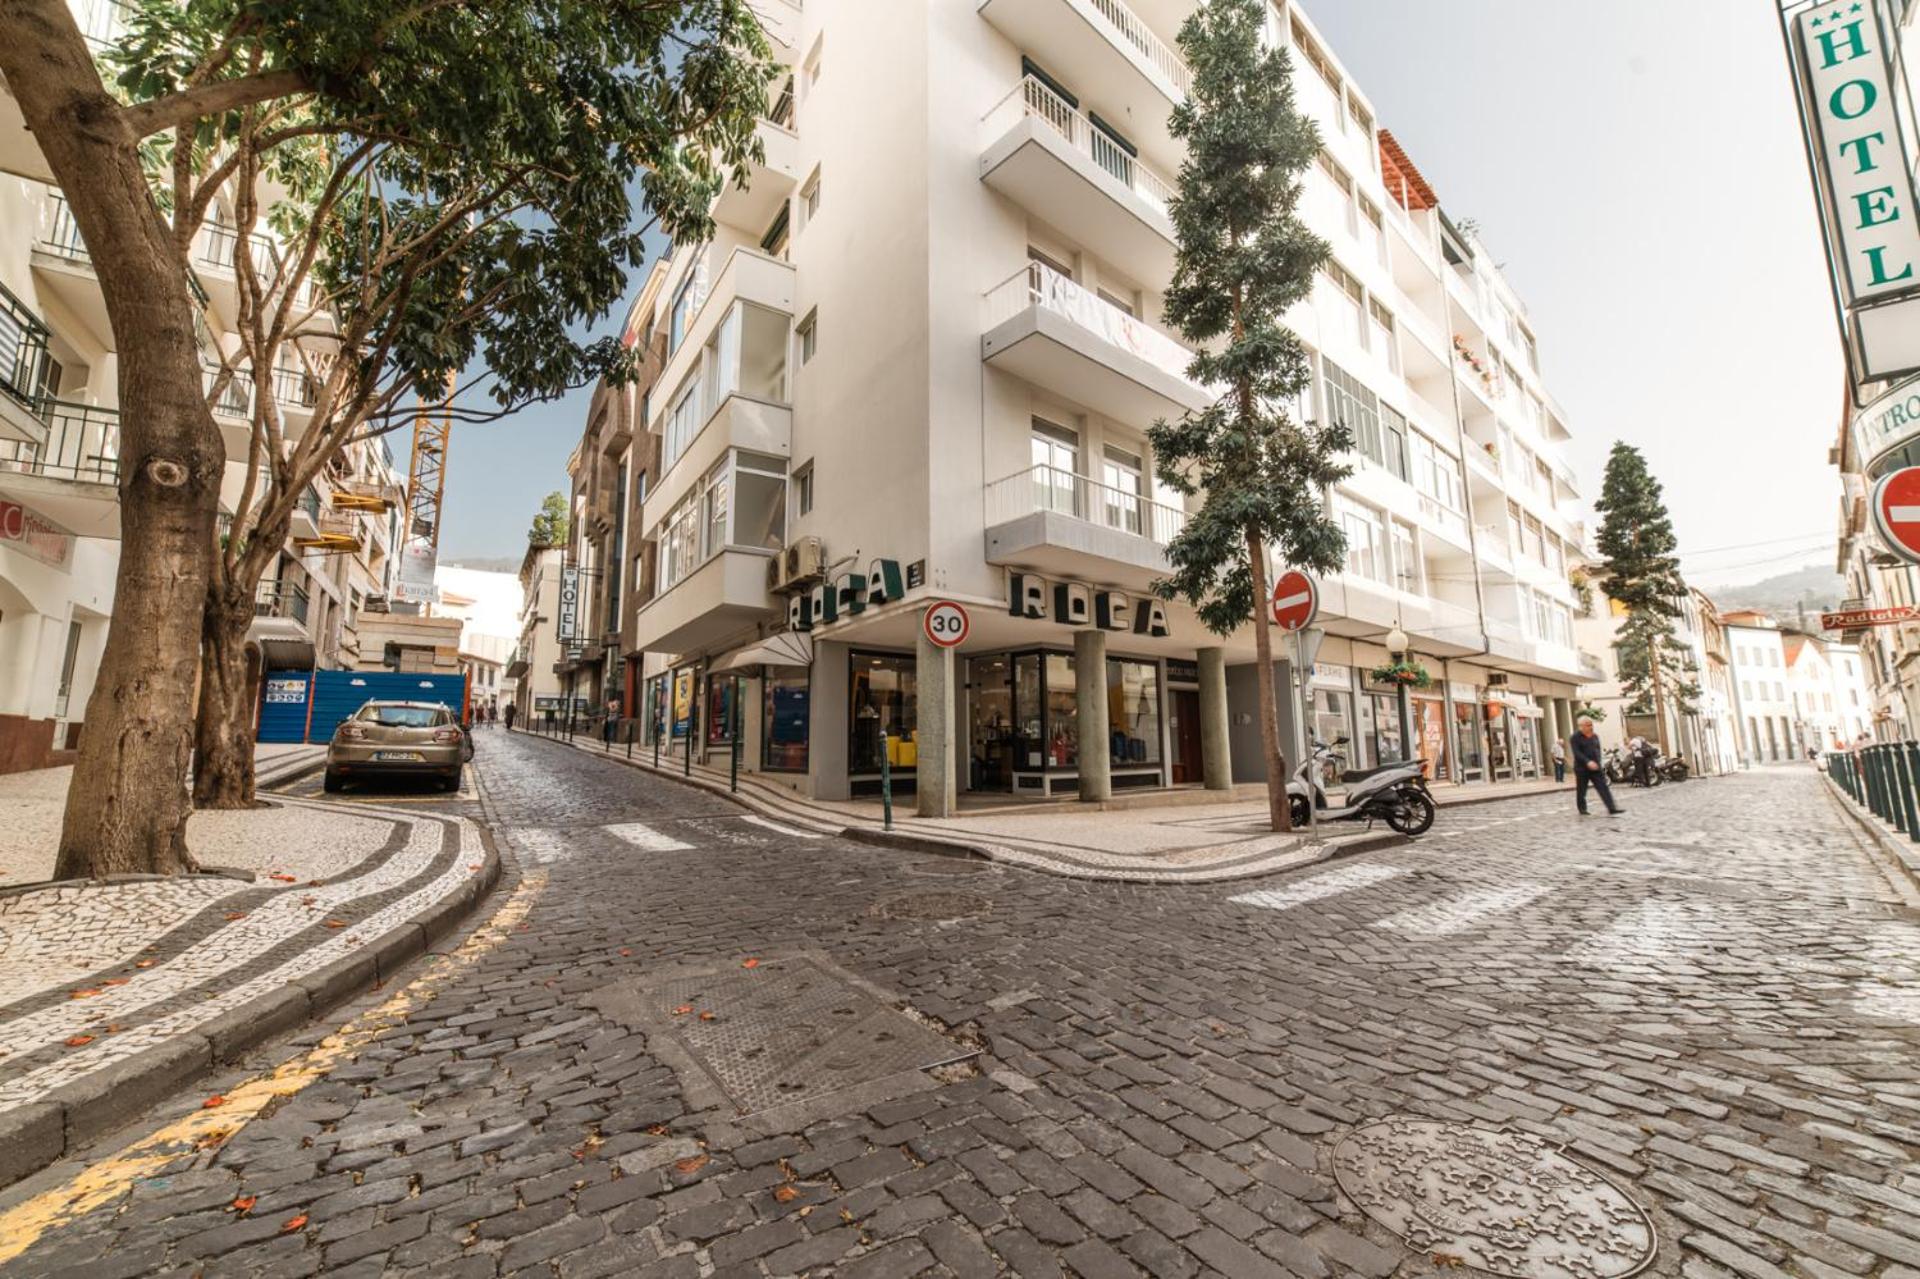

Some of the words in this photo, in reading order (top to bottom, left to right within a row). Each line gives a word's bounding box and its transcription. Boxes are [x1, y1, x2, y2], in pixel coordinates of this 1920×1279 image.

[1814, 19, 1912, 286] HOTEL
[562, 579, 576, 636] HOTEL
[789, 558, 905, 632] ROCA
[932, 615, 962, 633] 30
[1009, 573, 1170, 637] ROCA
